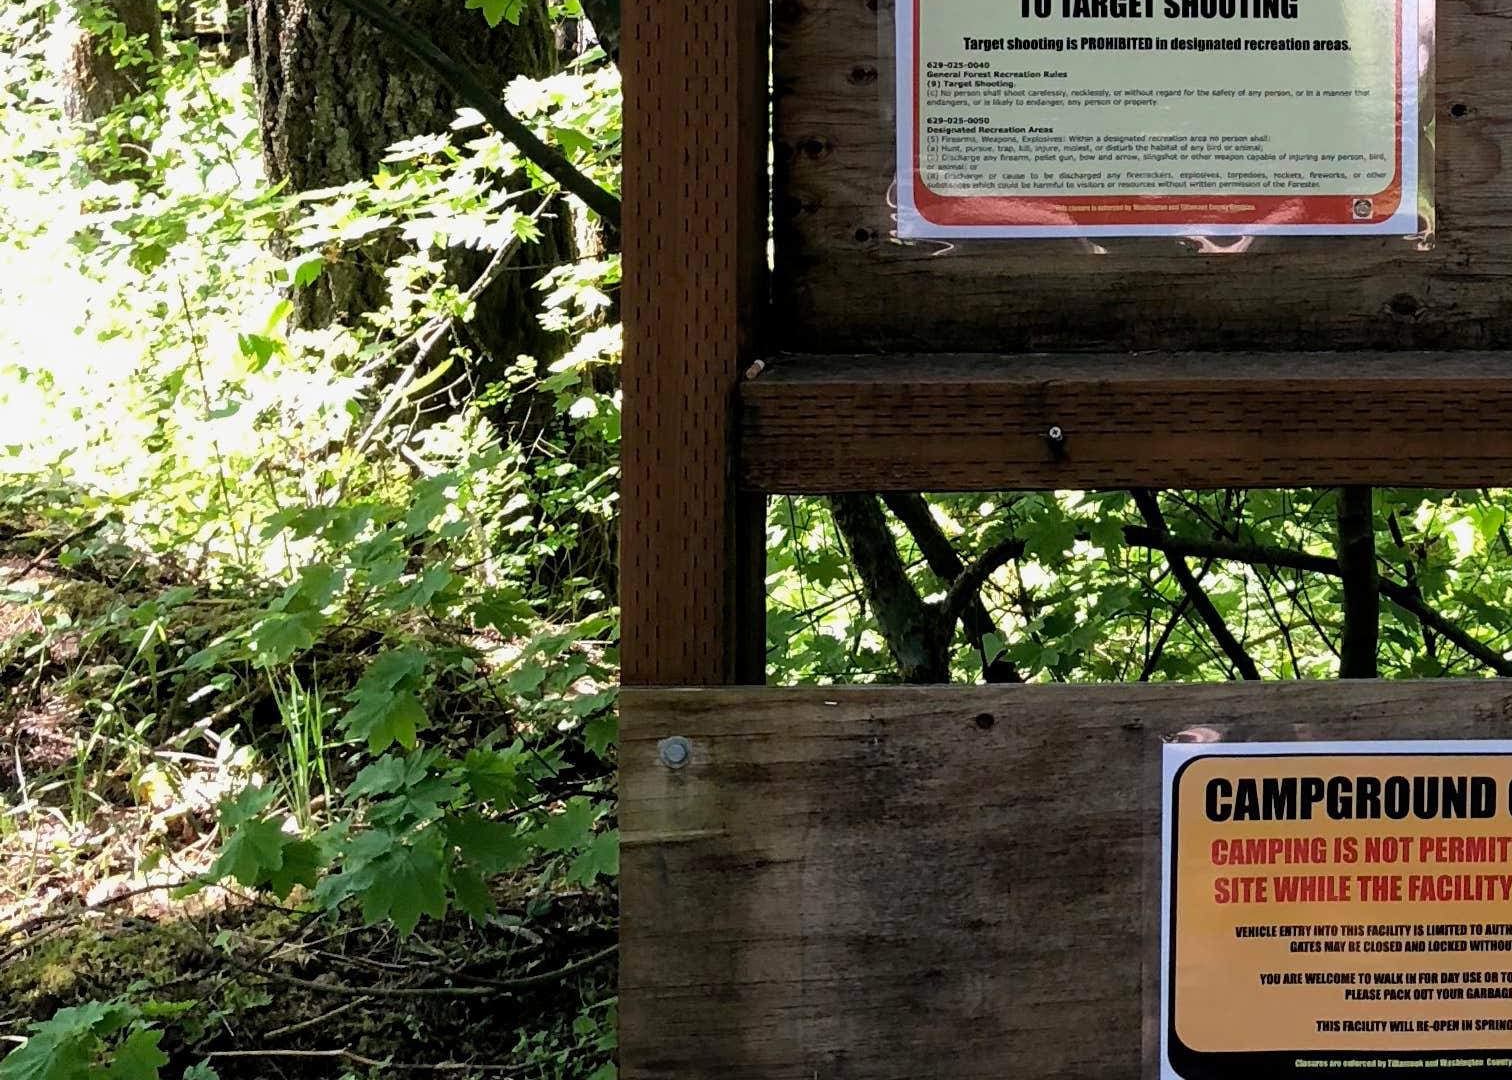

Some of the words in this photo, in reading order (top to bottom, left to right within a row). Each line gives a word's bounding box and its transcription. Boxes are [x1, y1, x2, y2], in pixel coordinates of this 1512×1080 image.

[962, 36, 1004, 52] Target
[1006, 36, 1064, 52] shooting
[1066, 36, 1078, 50] is
[1080, 36, 1153, 50] PROHIBITED
[1155, 36, 1168, 50] in
[1170, 37, 1242, 52] designated
[1244, 37, 1310, 51] recreation
[1312, 39, 1351, 51] areas.
[926, 61, 990, 69] 629-025-0040
[926, 70, 961, 78] General
[963, 70, 991, 78] Forest
[993, 70, 1041, 78] Recreation
[1043, 70, 1068, 78] Rules
[926, 79, 941, 88] (9)
[943, 80, 972, 89] Target
[926, 116, 990, 124] 629-025-0050
[926, 126, 976, 135] Designated
[978, 126, 1026, 134] Recreation
[1205, 776, 1496, 822] CAMPGROUND
[1211, 836, 1327, 865] CAMPING
[1333, 836, 1358, 864] IS
[1364, 836, 1414, 863] NOT
[1214, 876, 1267, 904] SITE
[1272, 875, 1351, 902] WHILE
[1356, 875, 1402, 902] THE
[1344, 988, 1381, 1000] PLEASE
[1383, 988, 1411, 1000] PACK
[1413, 988, 1434, 1000] OUT
[1436, 987, 1464, 1000] YOUR
[1315, 1020, 1341, 1032] THIS
[1342, 1020, 1387, 1032] FACILITY
[1389, 1020, 1414, 1032] WILL
[1416, 1019, 1459, 1032] RE-OPEN
[1461, 1019, 1473, 1031] IN
[1474, 1019, 1512, 1031] SPRING
